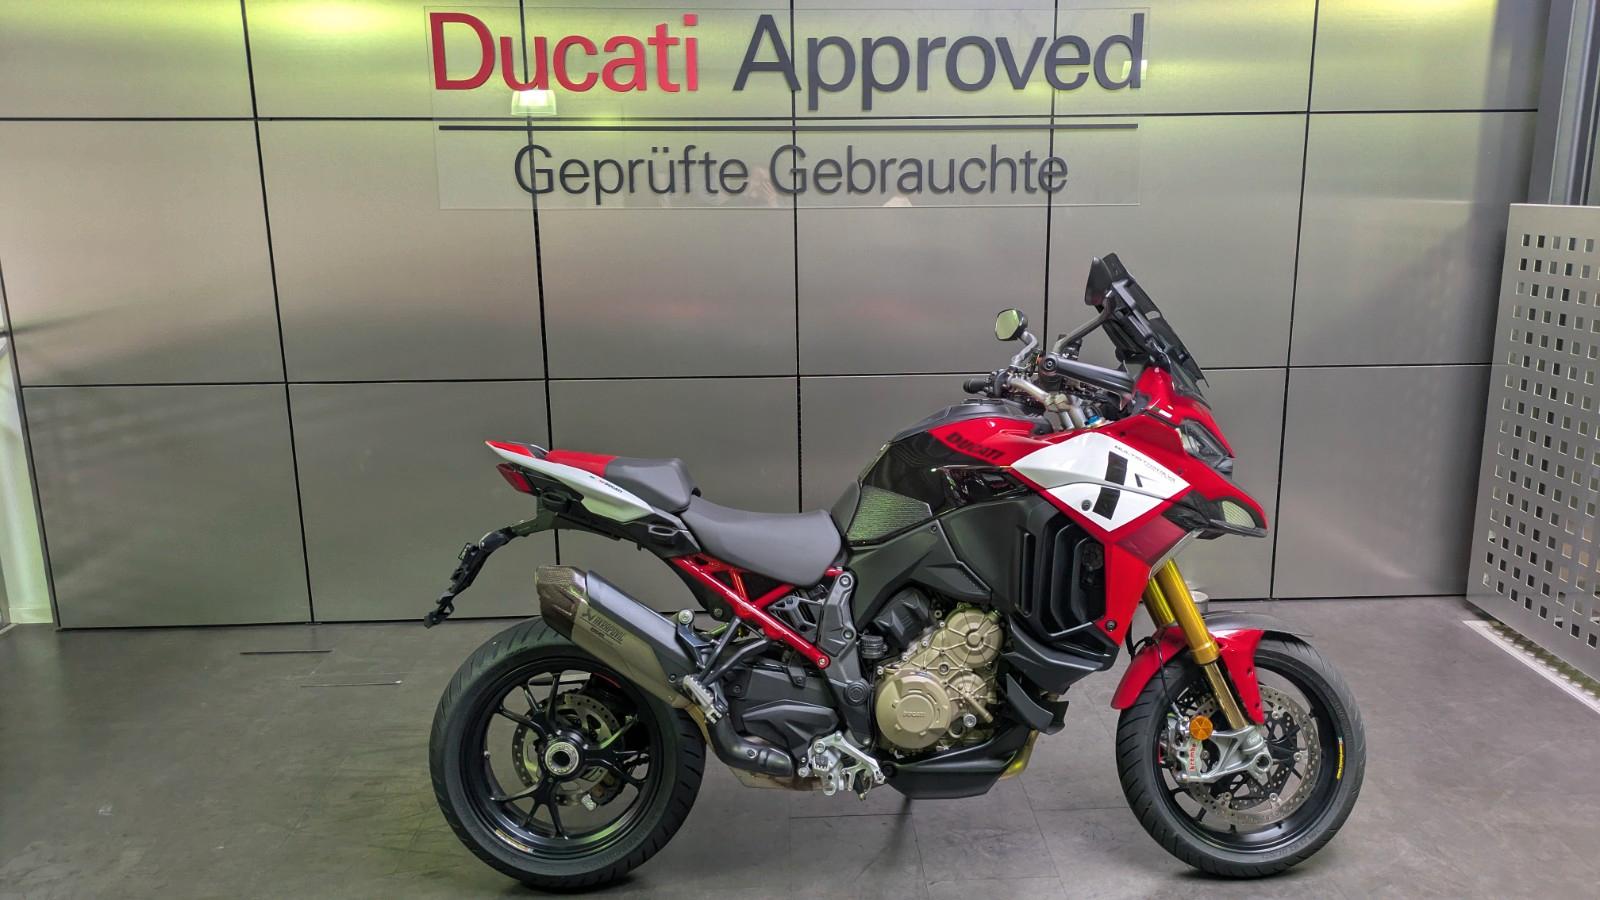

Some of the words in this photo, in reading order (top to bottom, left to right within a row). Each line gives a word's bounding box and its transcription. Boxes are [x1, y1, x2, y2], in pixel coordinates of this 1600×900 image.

[430, 12, 698, 92] Ducati
[732, 13, 1145, 111] Approved
[514, 144, 749, 206] Geprüfte
[769, 144, 1068, 194] Gebrauchte
